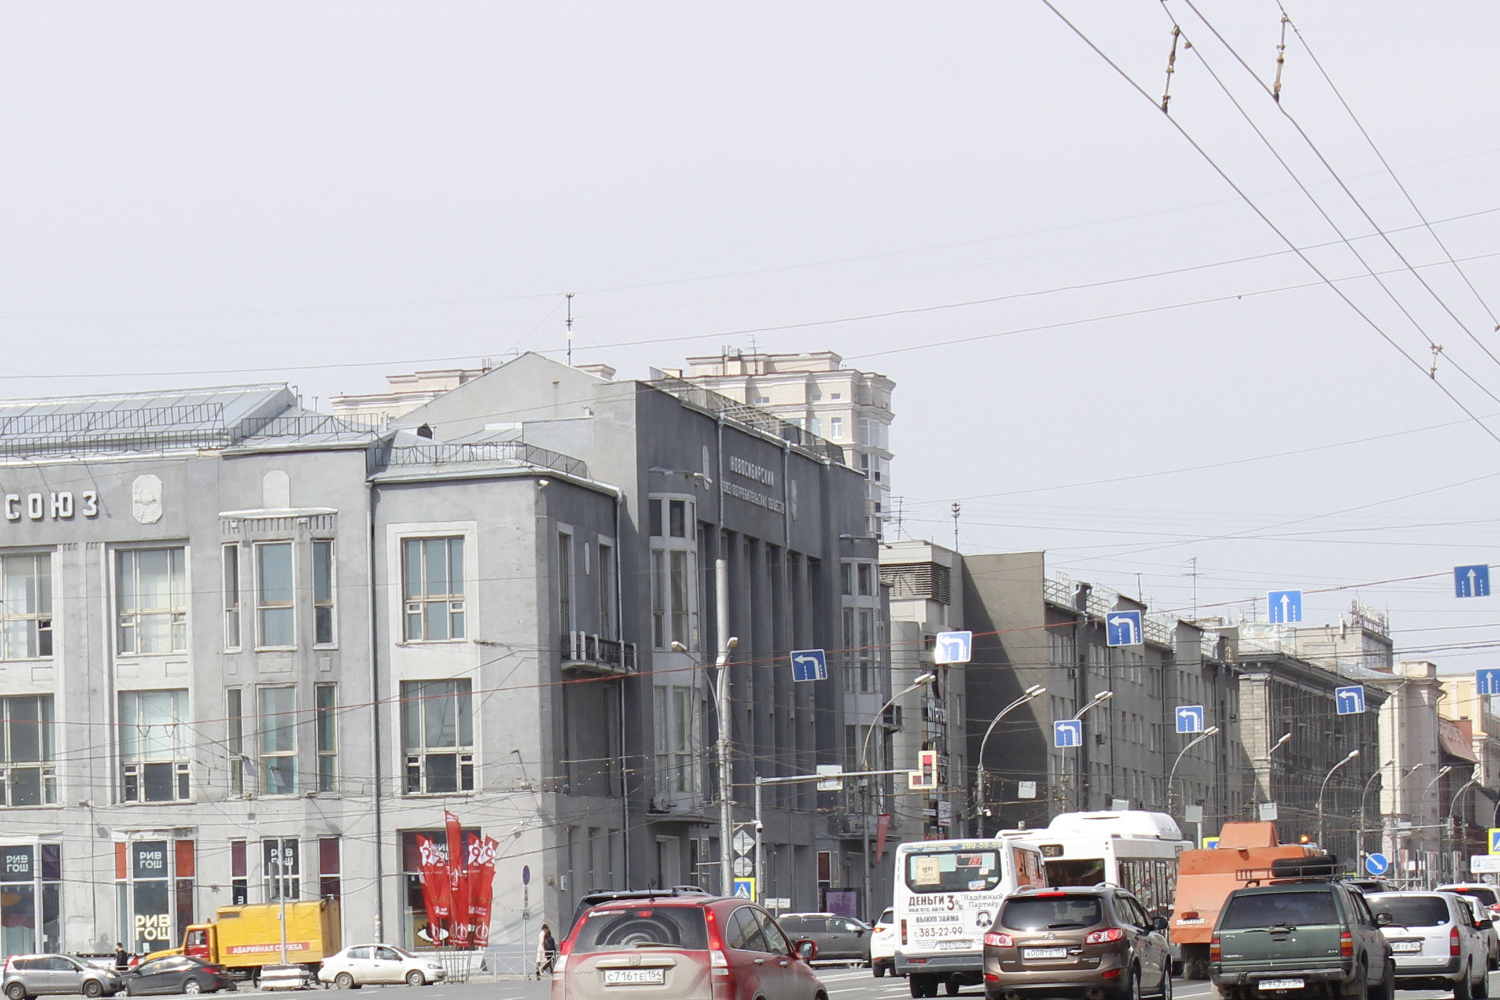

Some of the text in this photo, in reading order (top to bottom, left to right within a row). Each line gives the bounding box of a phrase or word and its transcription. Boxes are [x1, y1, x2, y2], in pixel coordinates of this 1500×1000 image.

[139, 851, 162, 860] РИВ
[271, 848, 293, 857] РВ
[6, 855, 28, 864] РИВ
[139, 860, 163, 869] ГОШ
[6, 863, 29, 872] ГОШ
[908, 895, 945, 907] ДЕНЬГИ
[135, 914, 170, 928] РИВ
[915, 914, 960, 924] ВЫКУП ЗАЙМА
[135, 927, 171, 941] ГОШ
[232, 944, 275, 954] АВАРИЙНАЯ
[607, 969, 662, 982] С716ТЕ 154
